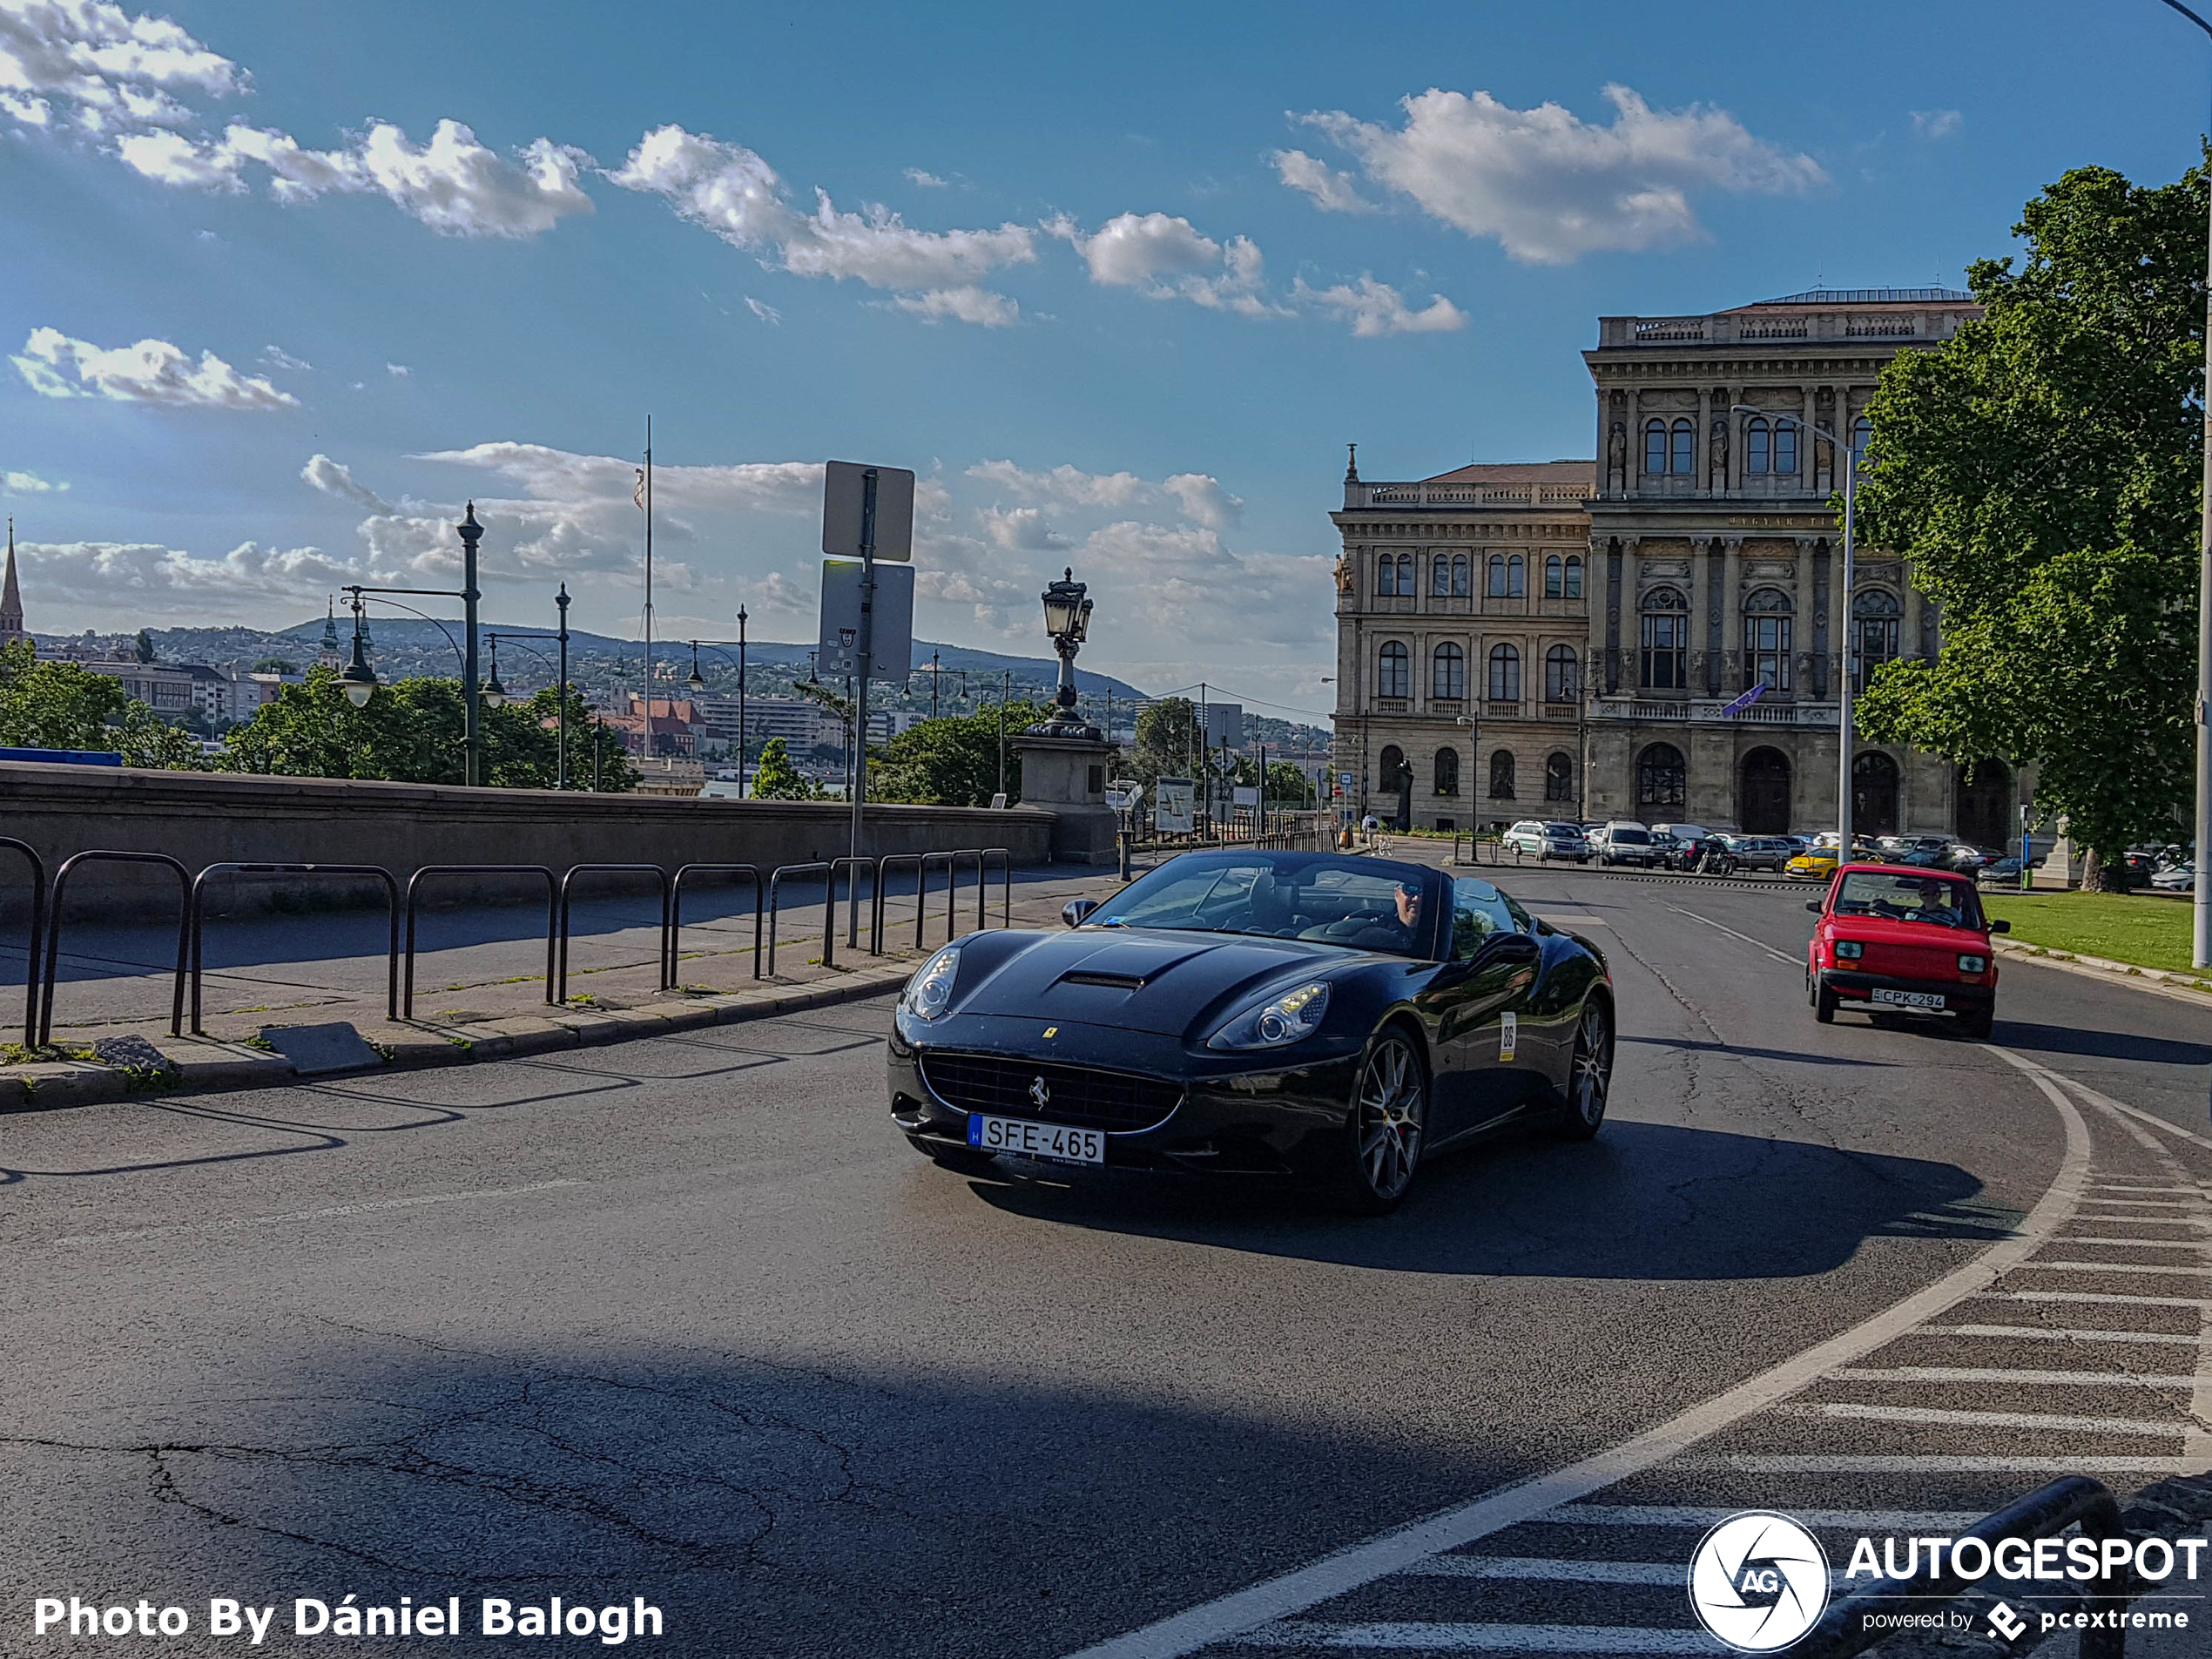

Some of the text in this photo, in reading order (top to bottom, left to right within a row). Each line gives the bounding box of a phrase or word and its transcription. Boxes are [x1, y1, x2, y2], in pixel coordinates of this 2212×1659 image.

[1883, 990, 1943, 1007] CPK-294
[1503, 1025, 1514, 1048] 86
[972, 1132, 979, 1142] H
[987, 1120, 1098, 1159] SFE-465
